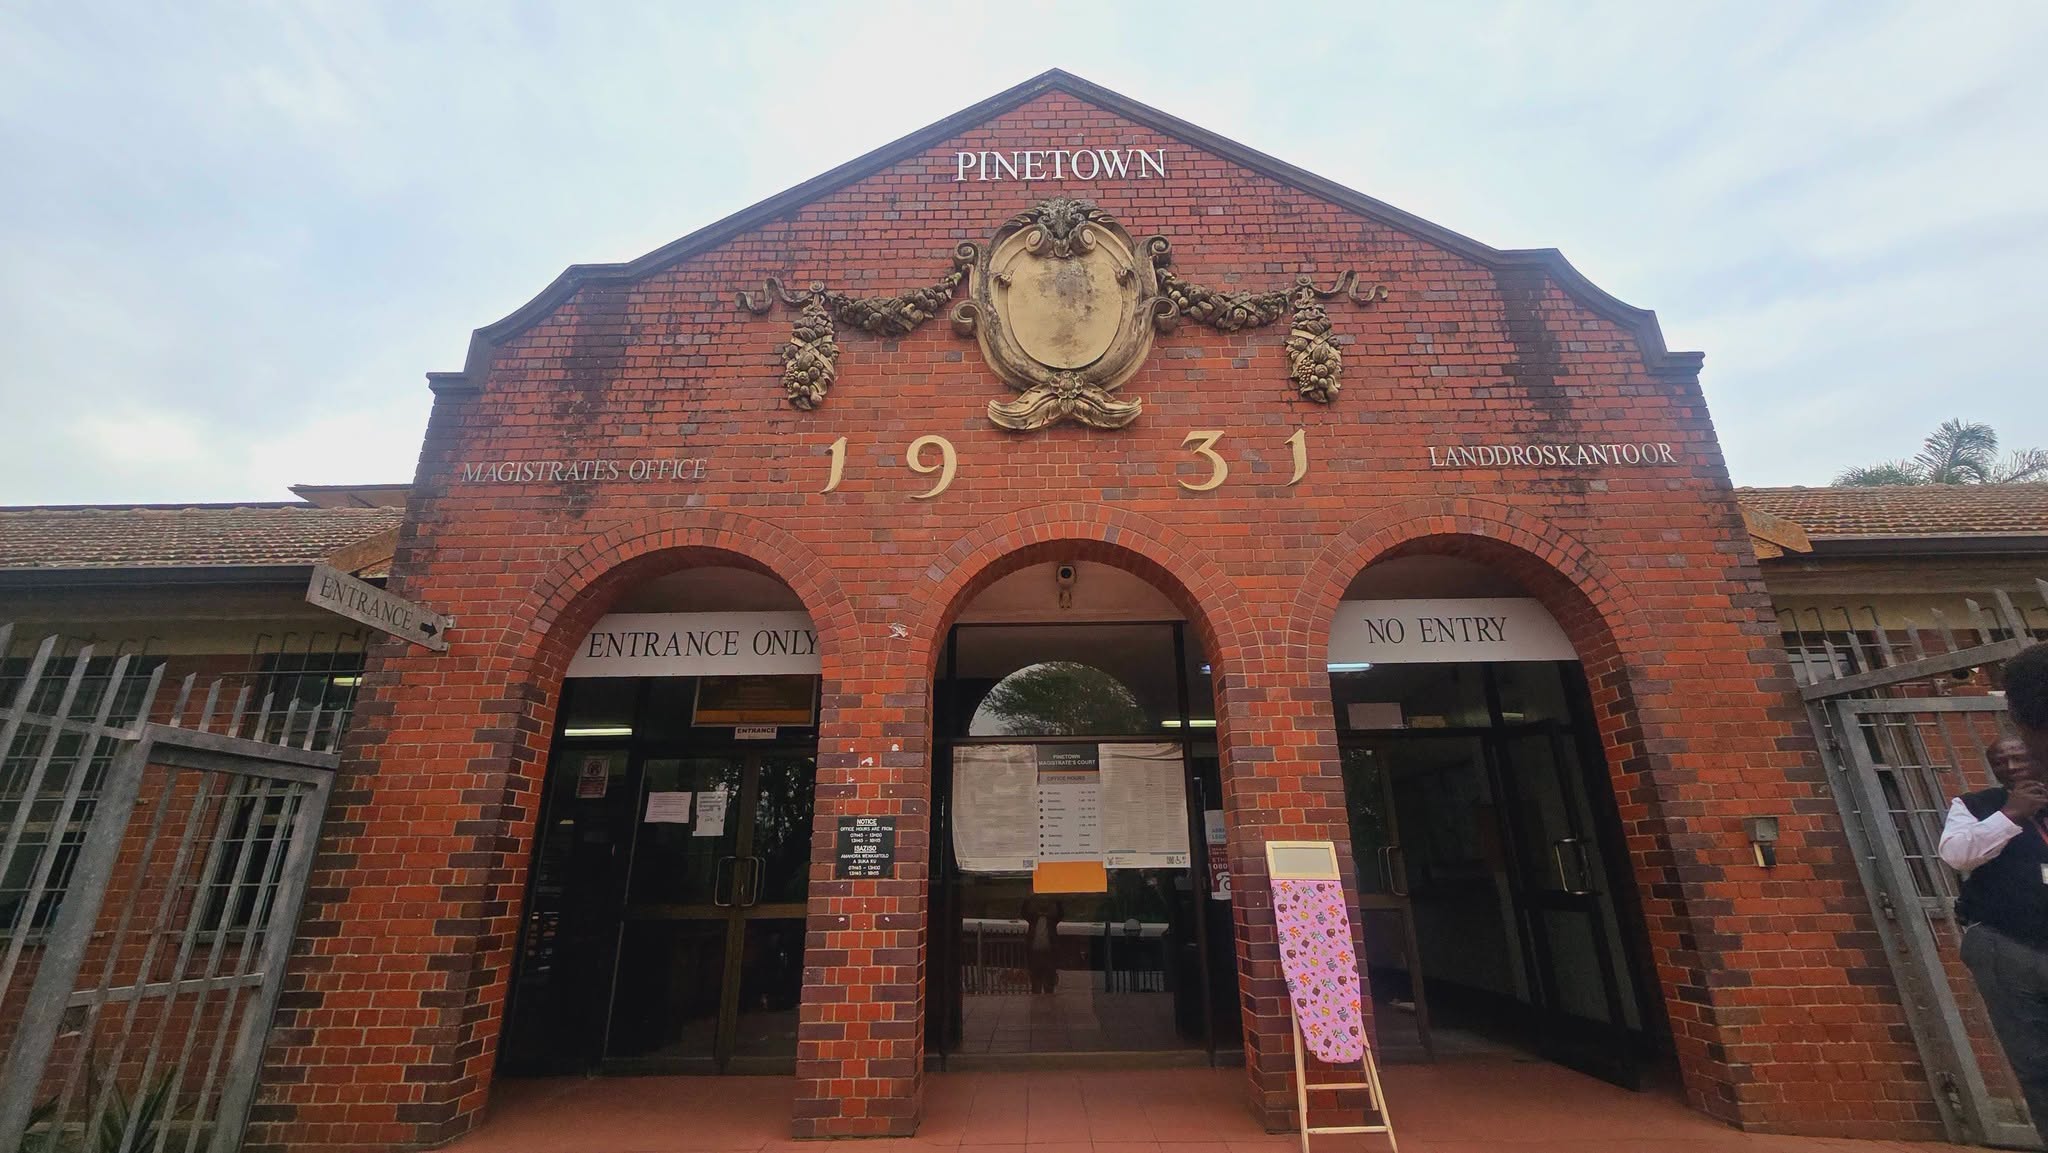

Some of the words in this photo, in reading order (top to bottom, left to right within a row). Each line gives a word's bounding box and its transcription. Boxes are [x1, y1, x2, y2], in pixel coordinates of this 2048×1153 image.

[954, 148, 1167, 182] PINETOWN
[1427, 442, 1677, 467] LANDDROSKANTOOR
[461, 459, 620, 482] MAGISTRATES
[628, 458, 708, 480] OFFICE
[319, 575, 414, 631] ENTRANCE
[1364, 617, 1405, 644] NO
[1417, 616, 1507, 643] ENTRY
[586, 630, 740, 658] ENTRANCE
[752, 629, 820, 656] ONLY
[857, 818, 877, 826] NOTICE
[854, 845, 877, 853] ISAZISO
